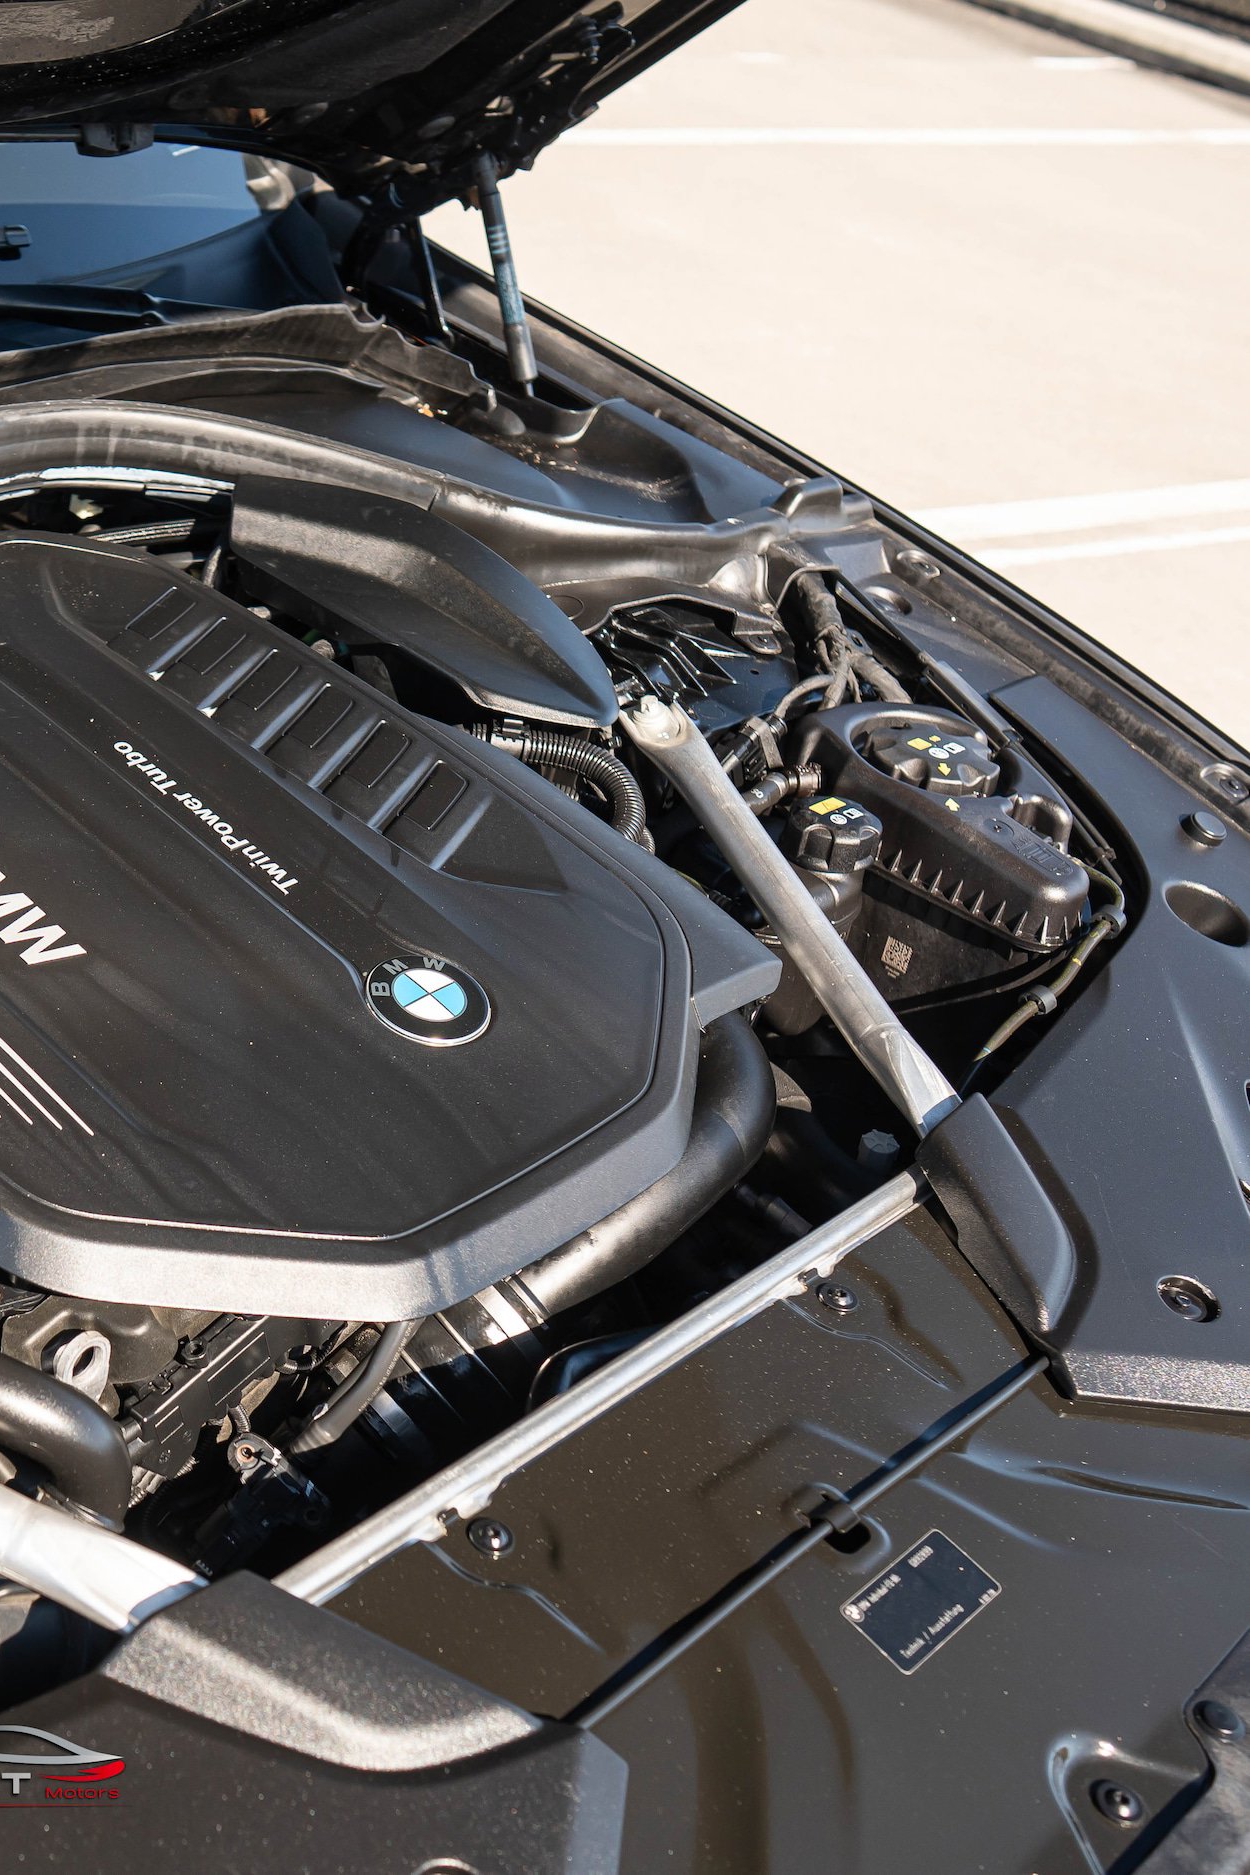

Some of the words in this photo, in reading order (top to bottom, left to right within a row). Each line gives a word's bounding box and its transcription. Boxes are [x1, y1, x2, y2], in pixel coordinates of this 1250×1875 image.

[113, 740, 178, 795] Turbo
[172, 791, 299, 896] TwinPower
[370, 956, 447, 997] BMW
